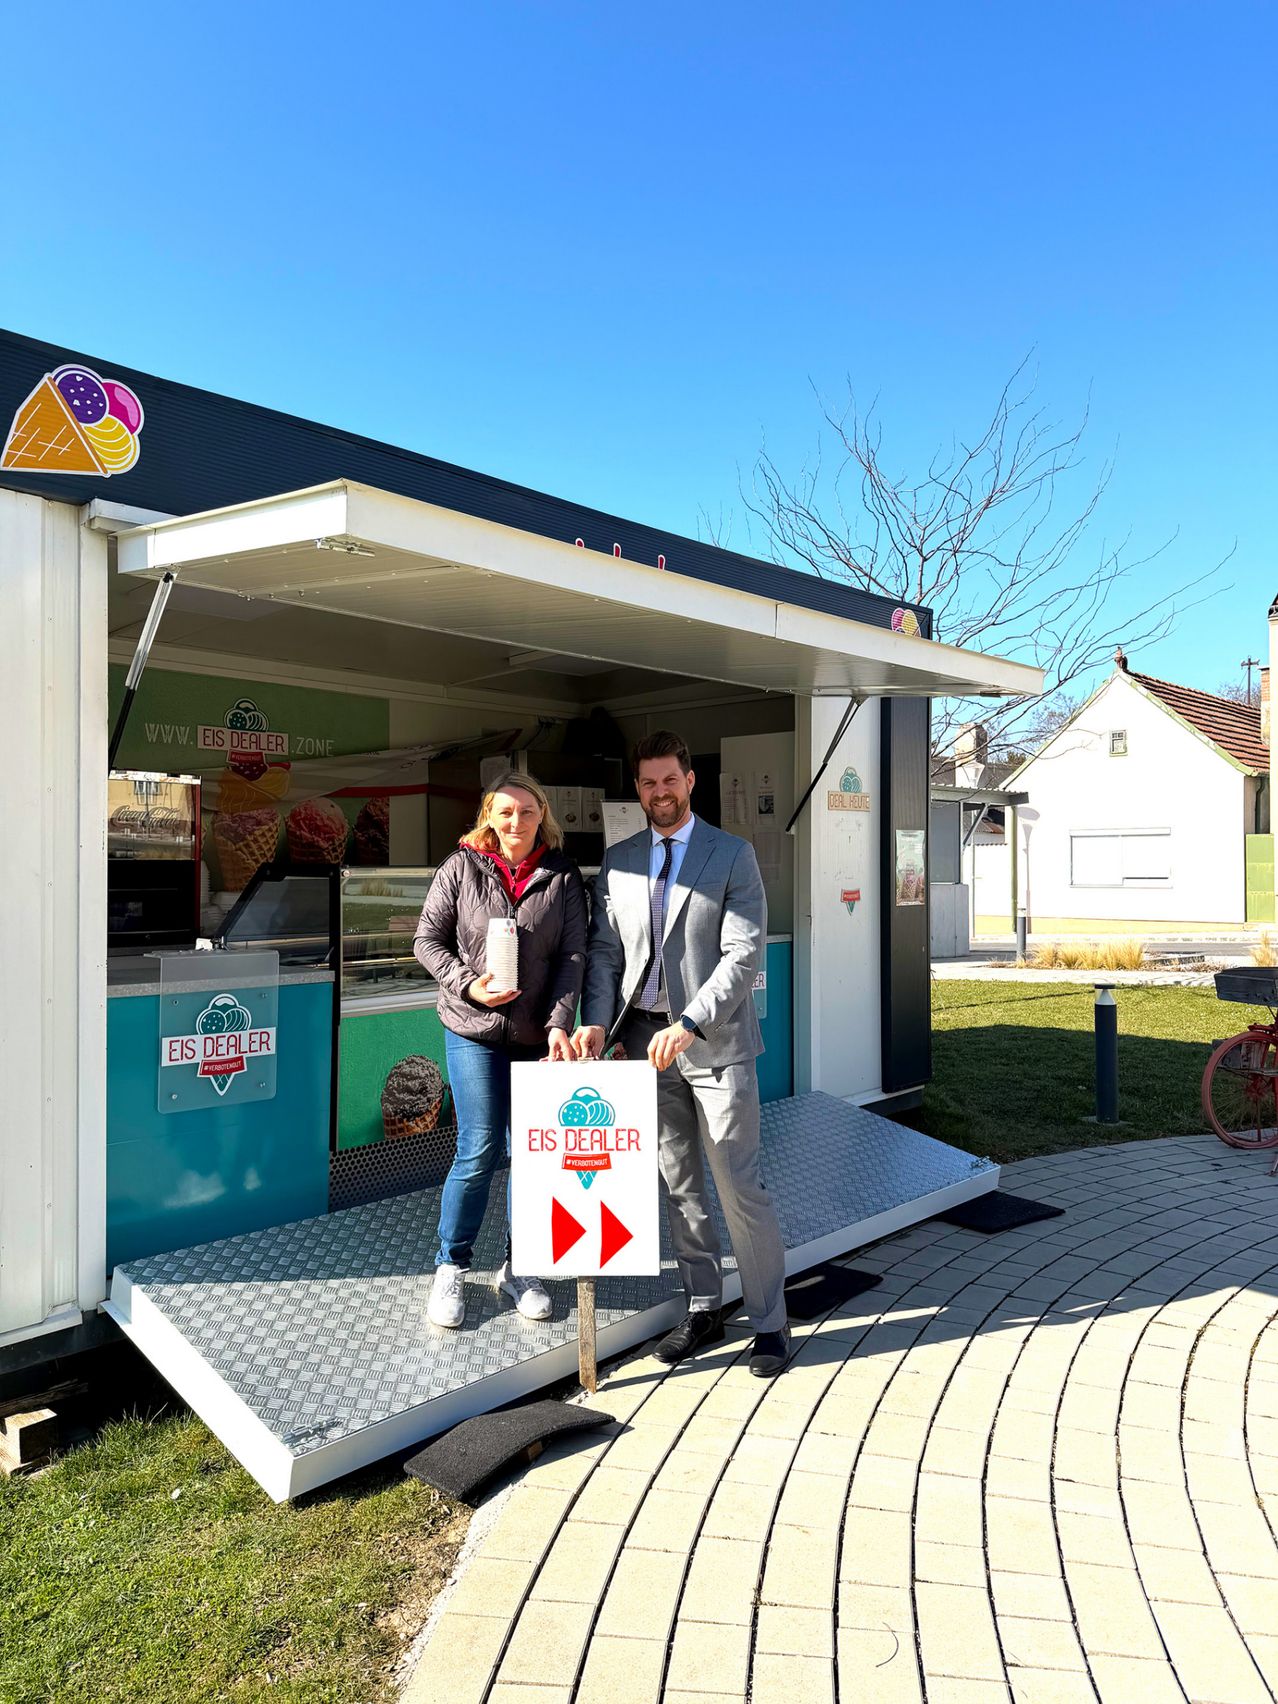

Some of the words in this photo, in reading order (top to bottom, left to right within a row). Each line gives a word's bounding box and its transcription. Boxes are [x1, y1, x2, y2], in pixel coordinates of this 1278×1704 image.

[145, 723, 194, 745] WWW.
[203, 728, 225, 747] EIS
[231, 731, 285, 753] DEALER
[829, 793, 848, 808] DEAL
[168, 1038, 196, 1062] EIS
[203, 1031, 271, 1058] DEALER
[528, 1129, 557, 1151] EIS
[565, 1129, 641, 1151] DEALER
